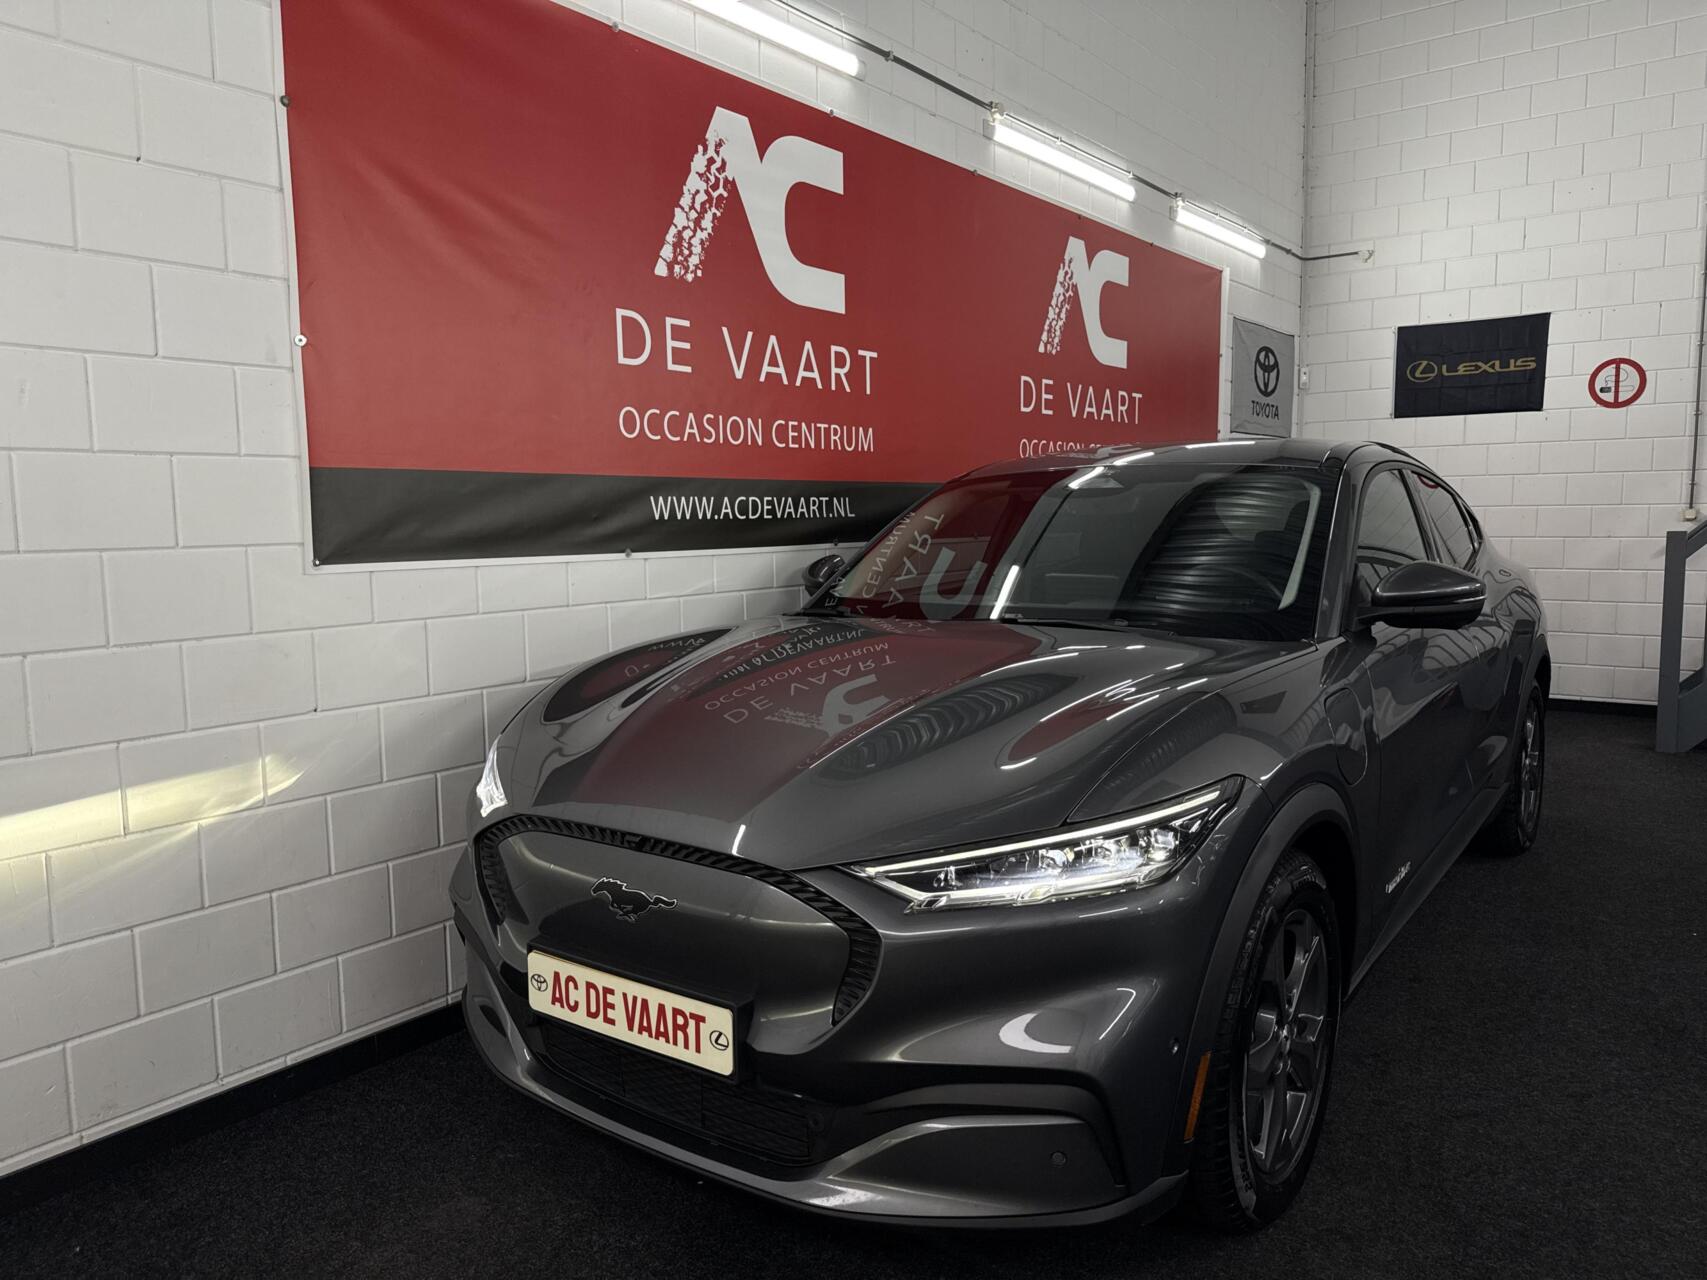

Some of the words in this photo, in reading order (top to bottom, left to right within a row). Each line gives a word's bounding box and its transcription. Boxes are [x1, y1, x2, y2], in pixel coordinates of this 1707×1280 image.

[654, 106, 846, 315] AC
[1038, 236, 1130, 369] AC
[615, 307, 693, 373] DE
[722, 326, 878, 394] VAART
[1441, 357, 1537, 376] LEXUS
[1020, 375, 1054, 415] DE
[1067, 382, 1143, 425] VAART
[1251, 400, 1280, 420] TOYOTA
[619, 406, 763, 446] OCCASION
[772, 420, 874, 452] CENTRUM
[650, 495, 856, 520] WWW.ACDEVAART.NL
[551, 970, 579, 1012] AC
[585, 981, 616, 1026] DE
[622, 992, 707, 1054] VAART
